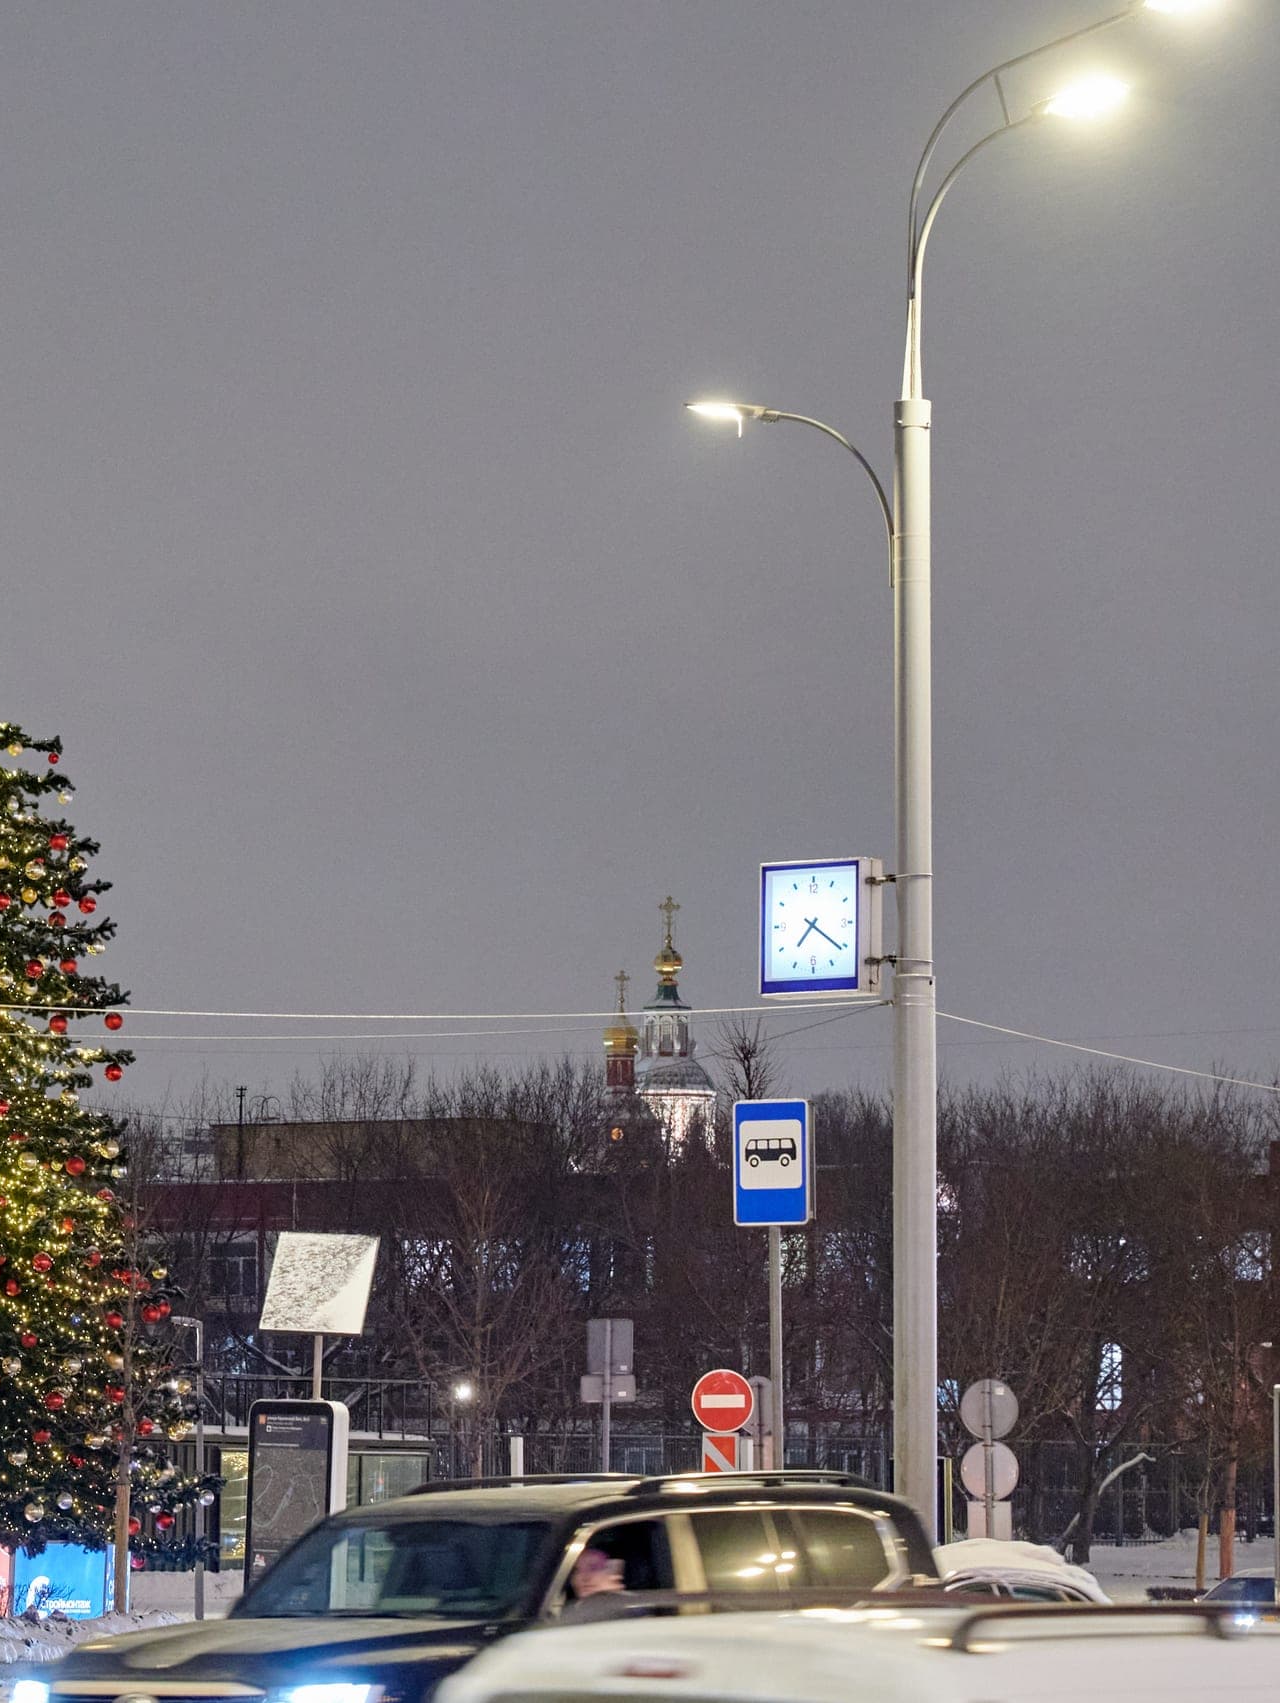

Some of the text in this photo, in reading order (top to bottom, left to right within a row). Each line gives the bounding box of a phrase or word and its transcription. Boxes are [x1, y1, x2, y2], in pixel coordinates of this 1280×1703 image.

[809, 884, 818, 894] 12
[781, 922, 787, 932] 9
[841, 919, 847, 928] 3
[810, 955, 816, 966] 6
